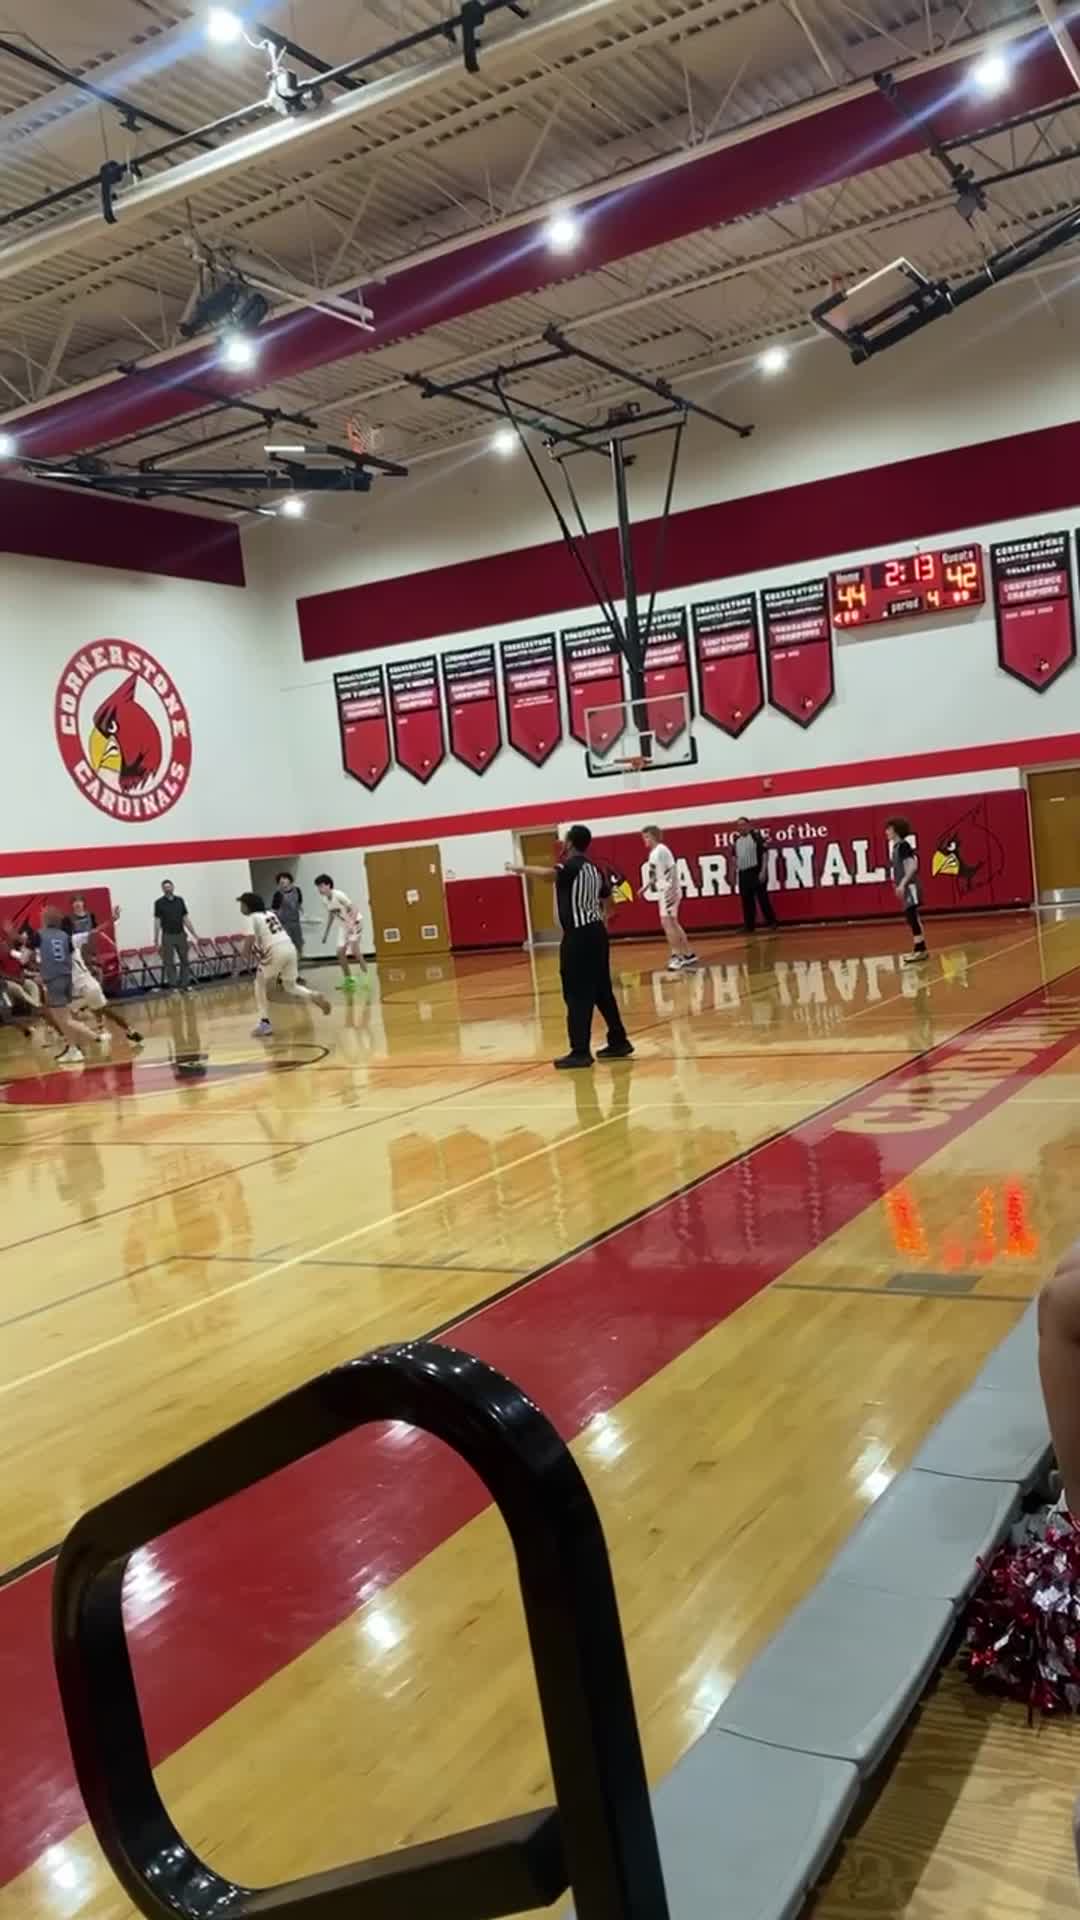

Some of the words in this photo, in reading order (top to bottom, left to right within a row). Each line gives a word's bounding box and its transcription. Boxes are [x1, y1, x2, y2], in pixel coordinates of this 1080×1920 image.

[942, 550, 974, 563] Guests
[885, 554, 934, 587] 2:13
[946, 562, 976, 588] 42
[838, 584, 866, 609] 44
[891, 598, 920, 613] period
[927, 590, 939, 607] 4
[59, 645, 188, 738] CORNERSTONE
[73, 761, 185, 817] CARDINALS
[714, 828, 772, 848] HOE
[775, 824, 795, 841] of
[797, 823, 828, 839] the
[641, 834, 917, 902] CARINAL
